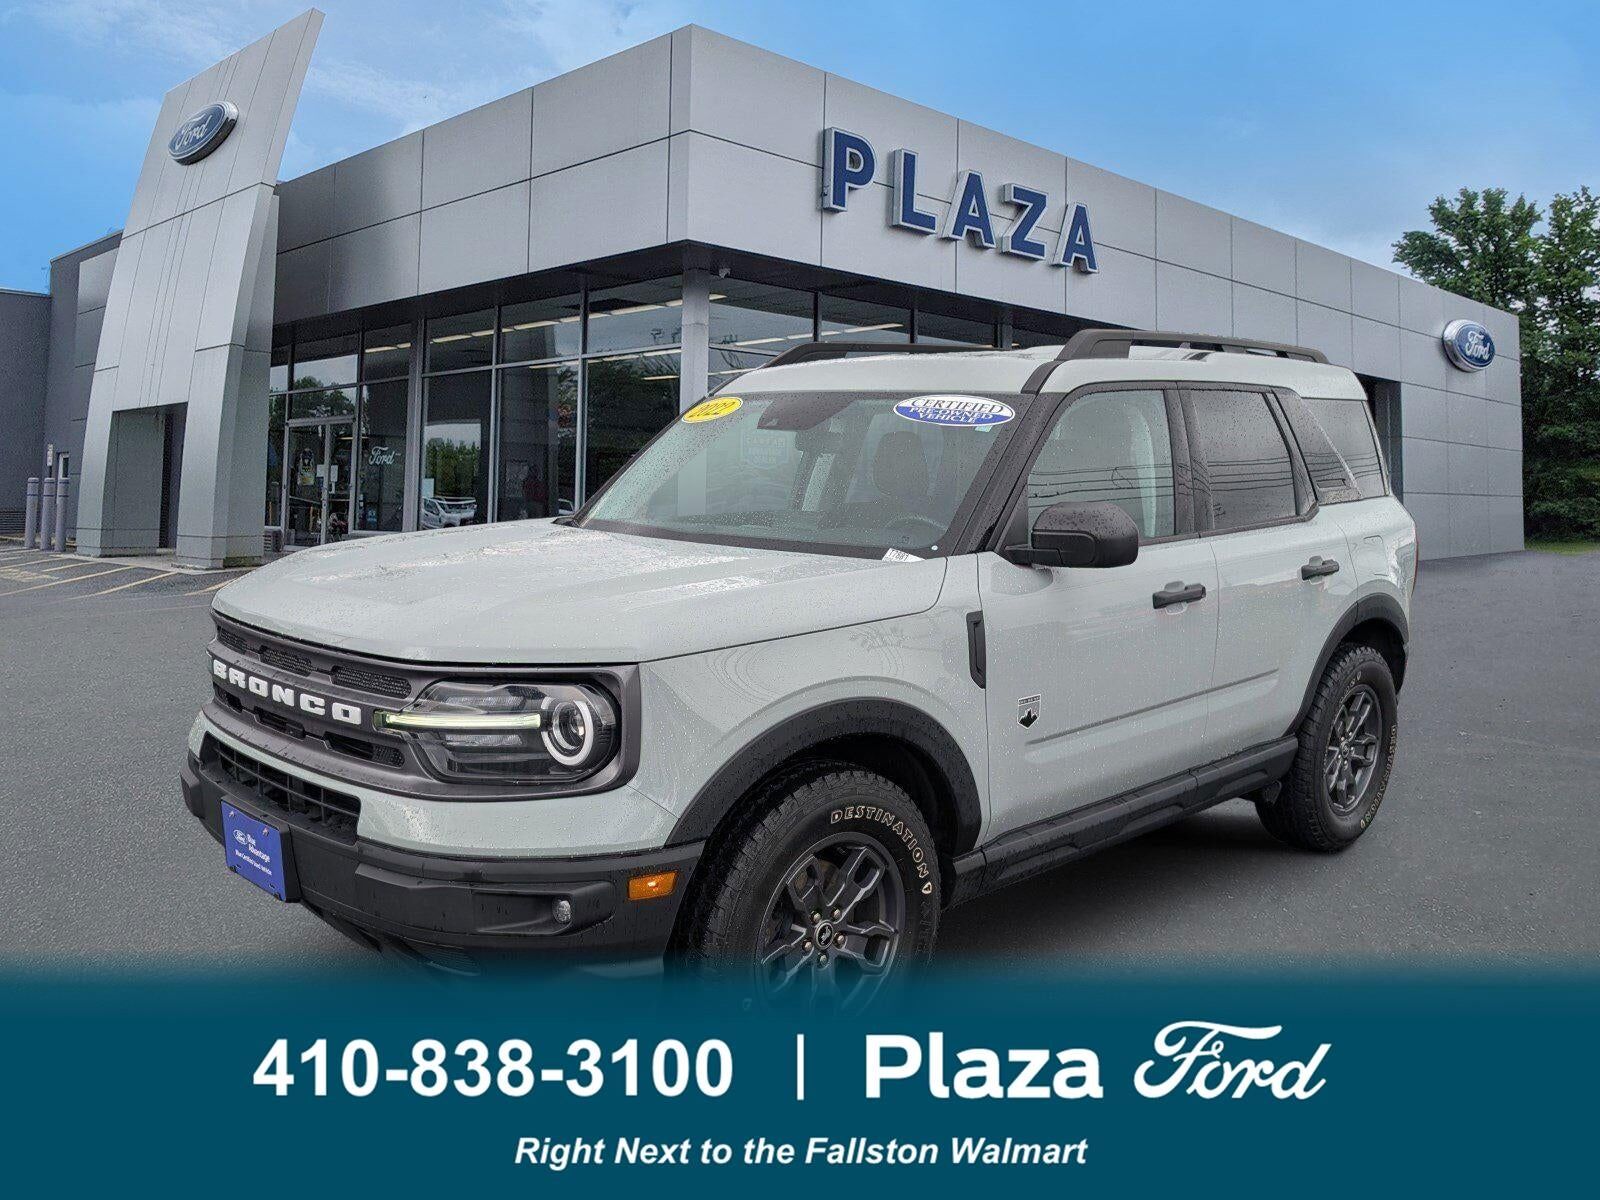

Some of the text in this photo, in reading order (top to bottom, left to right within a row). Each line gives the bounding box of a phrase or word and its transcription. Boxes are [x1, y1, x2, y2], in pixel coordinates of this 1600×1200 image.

[822, 127, 1099, 274] PLAZA
[909, 406, 994, 420] PRE-OWNED
[911, 398, 1004, 414] CERTIFIED
[919, 412, 977, 424] VEHICLE
[368, 446, 395, 465] Ford
[213, 658, 362, 725] BRONCO
[830, 805, 930, 879] DESTINATION
